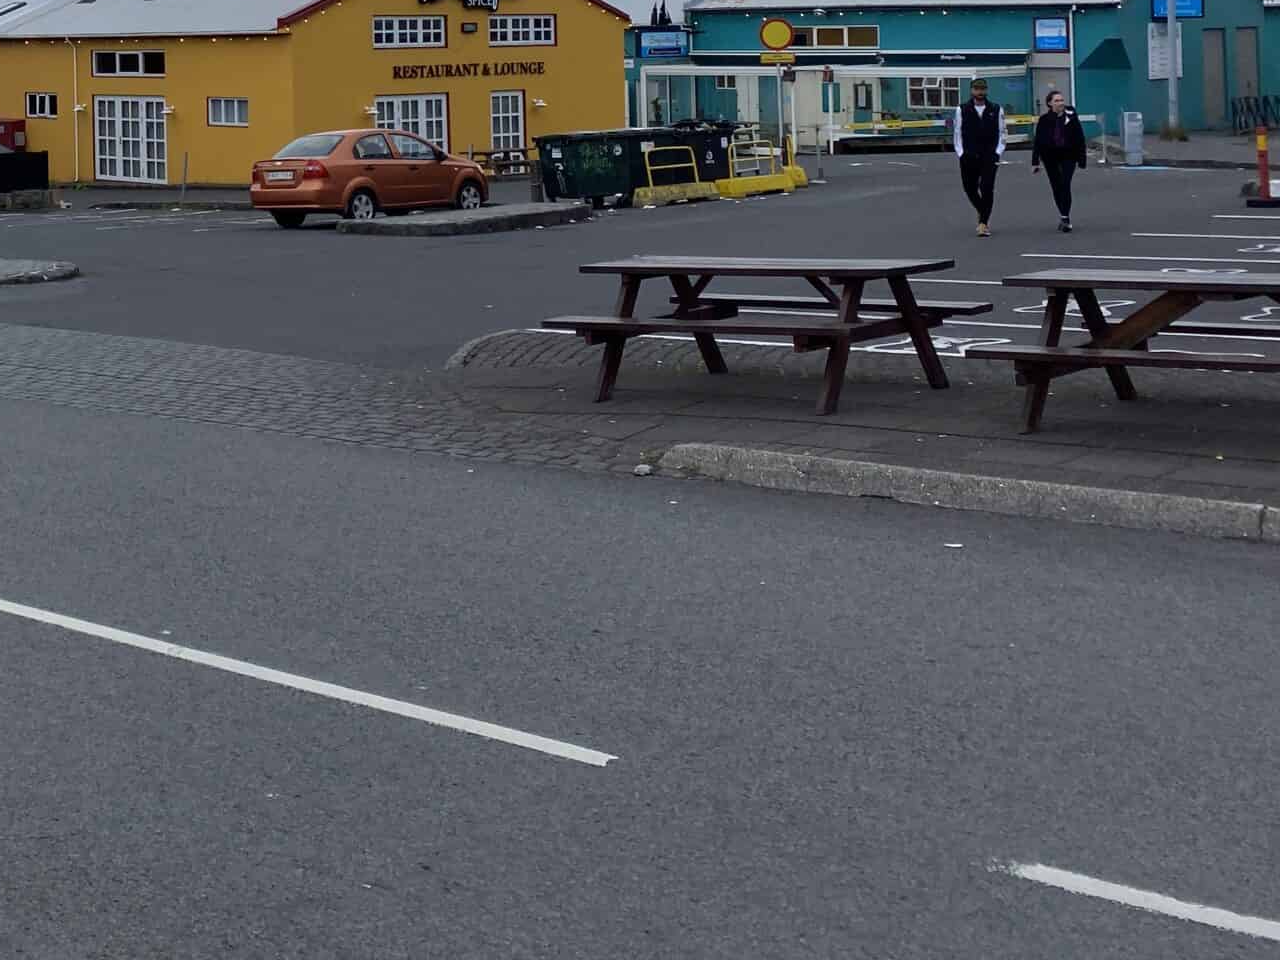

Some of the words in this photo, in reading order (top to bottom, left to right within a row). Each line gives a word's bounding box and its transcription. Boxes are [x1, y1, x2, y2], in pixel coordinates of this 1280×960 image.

[392, 63, 480, 79] RESTAURANT
[481, 63, 490, 76] &
[494, 61, 545, 76] LOUNGE
